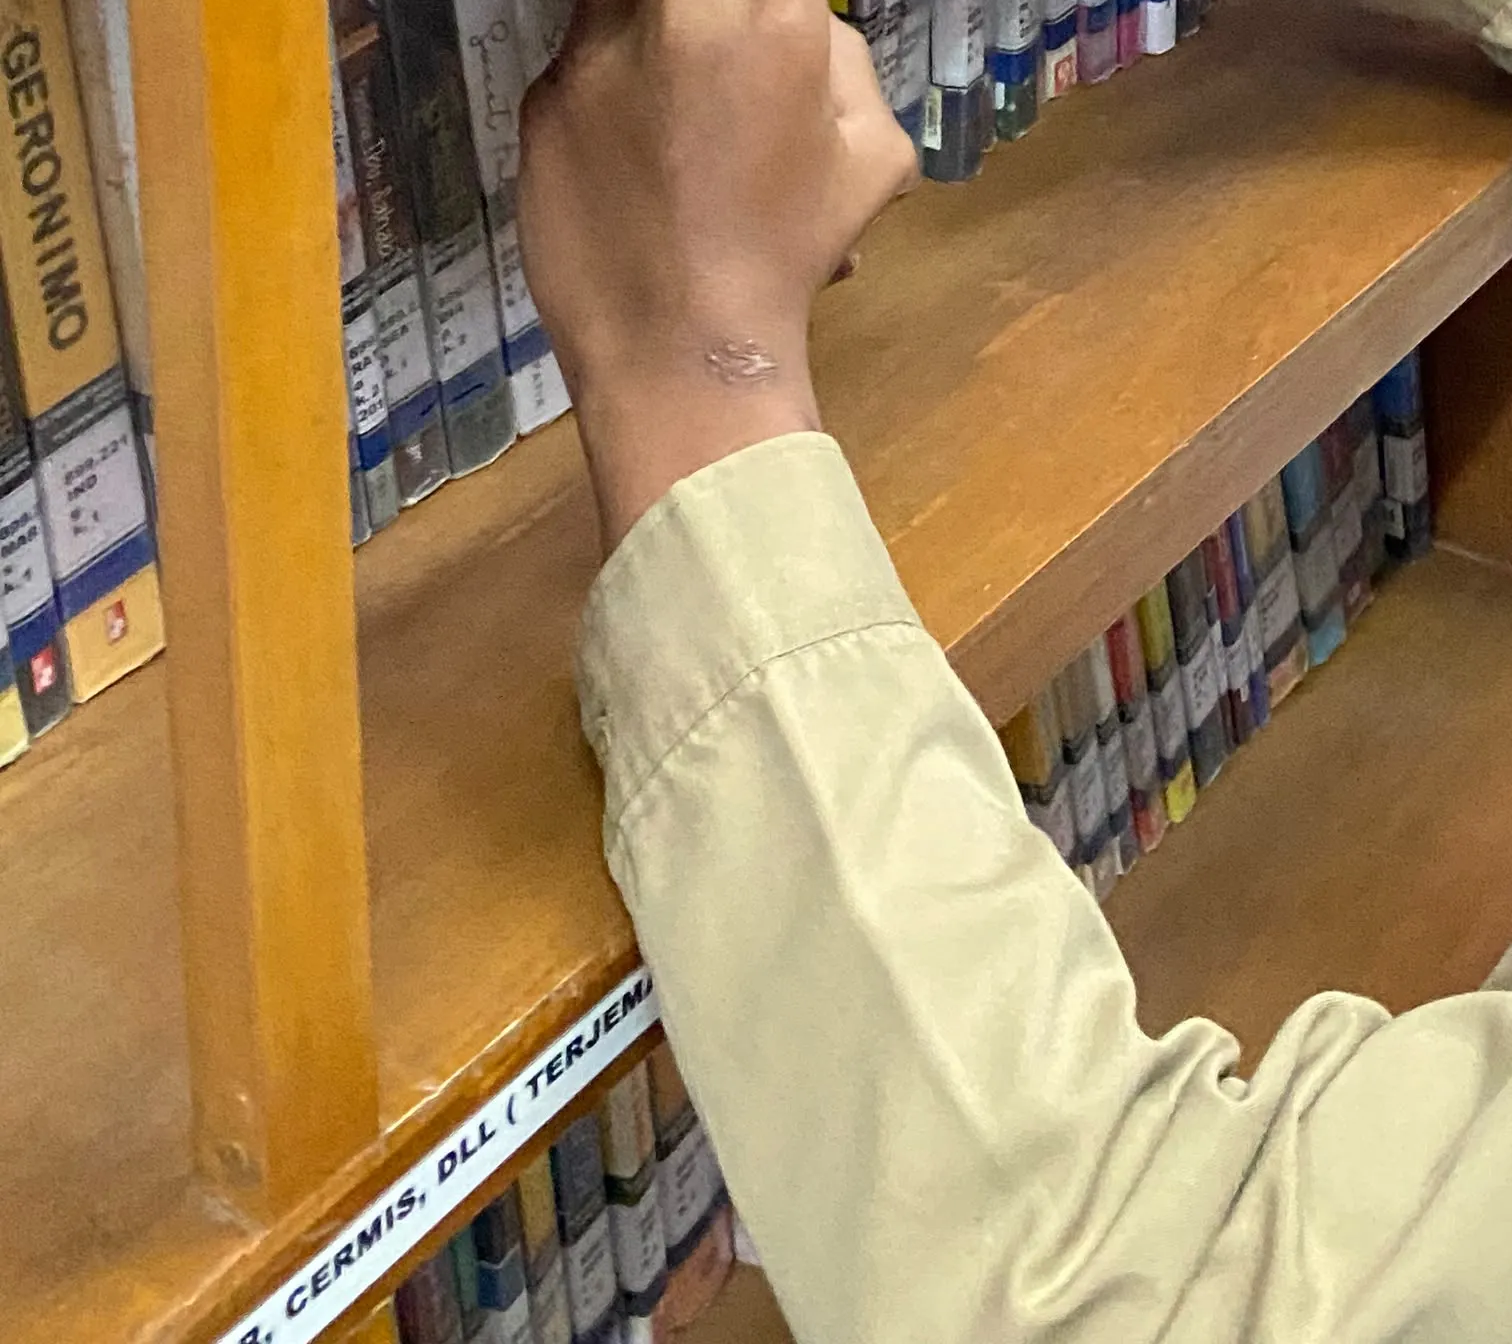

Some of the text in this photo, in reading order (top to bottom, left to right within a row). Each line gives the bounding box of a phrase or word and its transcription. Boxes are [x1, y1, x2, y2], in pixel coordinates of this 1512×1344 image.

[2, 26, 89, 352] GERONIMO
[285, 1183, 428, 1319] CERMIS,
[436, 1119, 497, 1185] DLL
